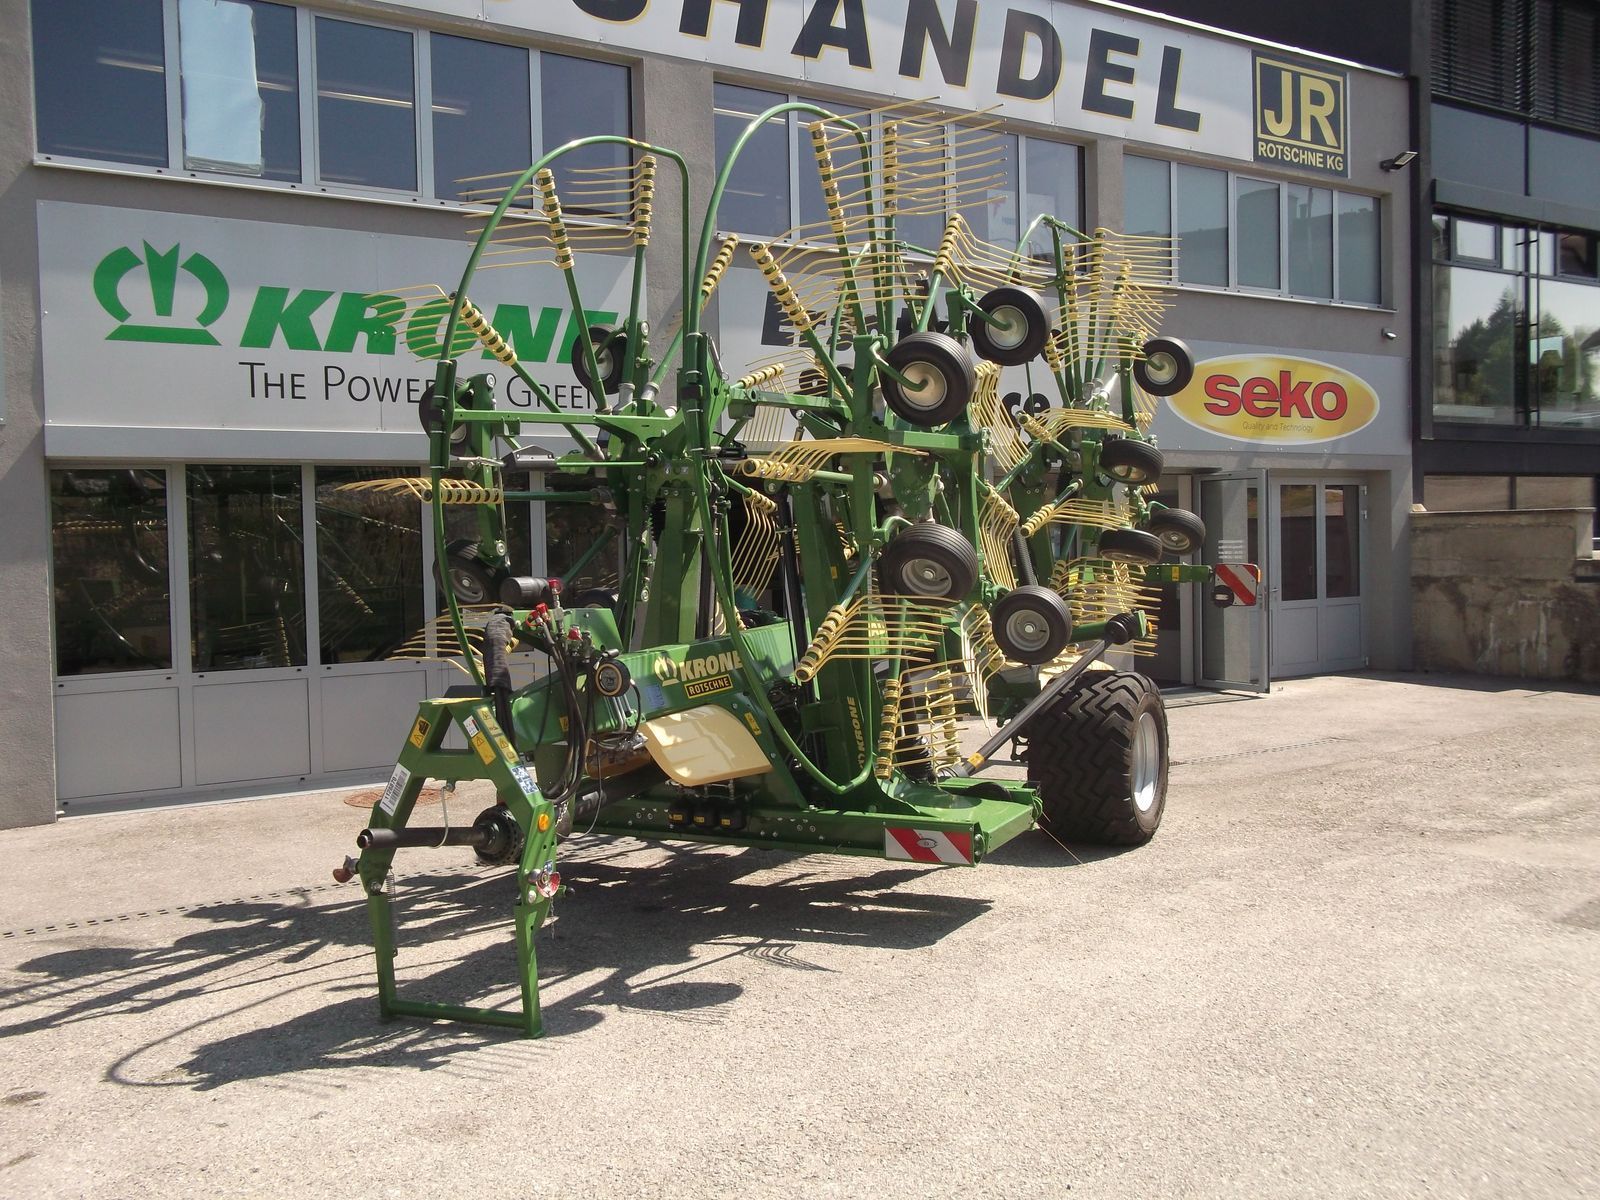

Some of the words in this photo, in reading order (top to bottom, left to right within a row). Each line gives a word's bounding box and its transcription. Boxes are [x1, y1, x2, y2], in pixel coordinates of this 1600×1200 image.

[572, 0, 1201, 132] HANDEL
[1264, 71, 1338, 147] JR
[1258, 141, 1324, 168] ROTSCHNE
[1327, 155, 1344, 171] KG
[1204, 371, 1347, 421] seko
[689, 677, 730, 696] ROTSCHNE
[847, 696, 866, 752] KRONE
